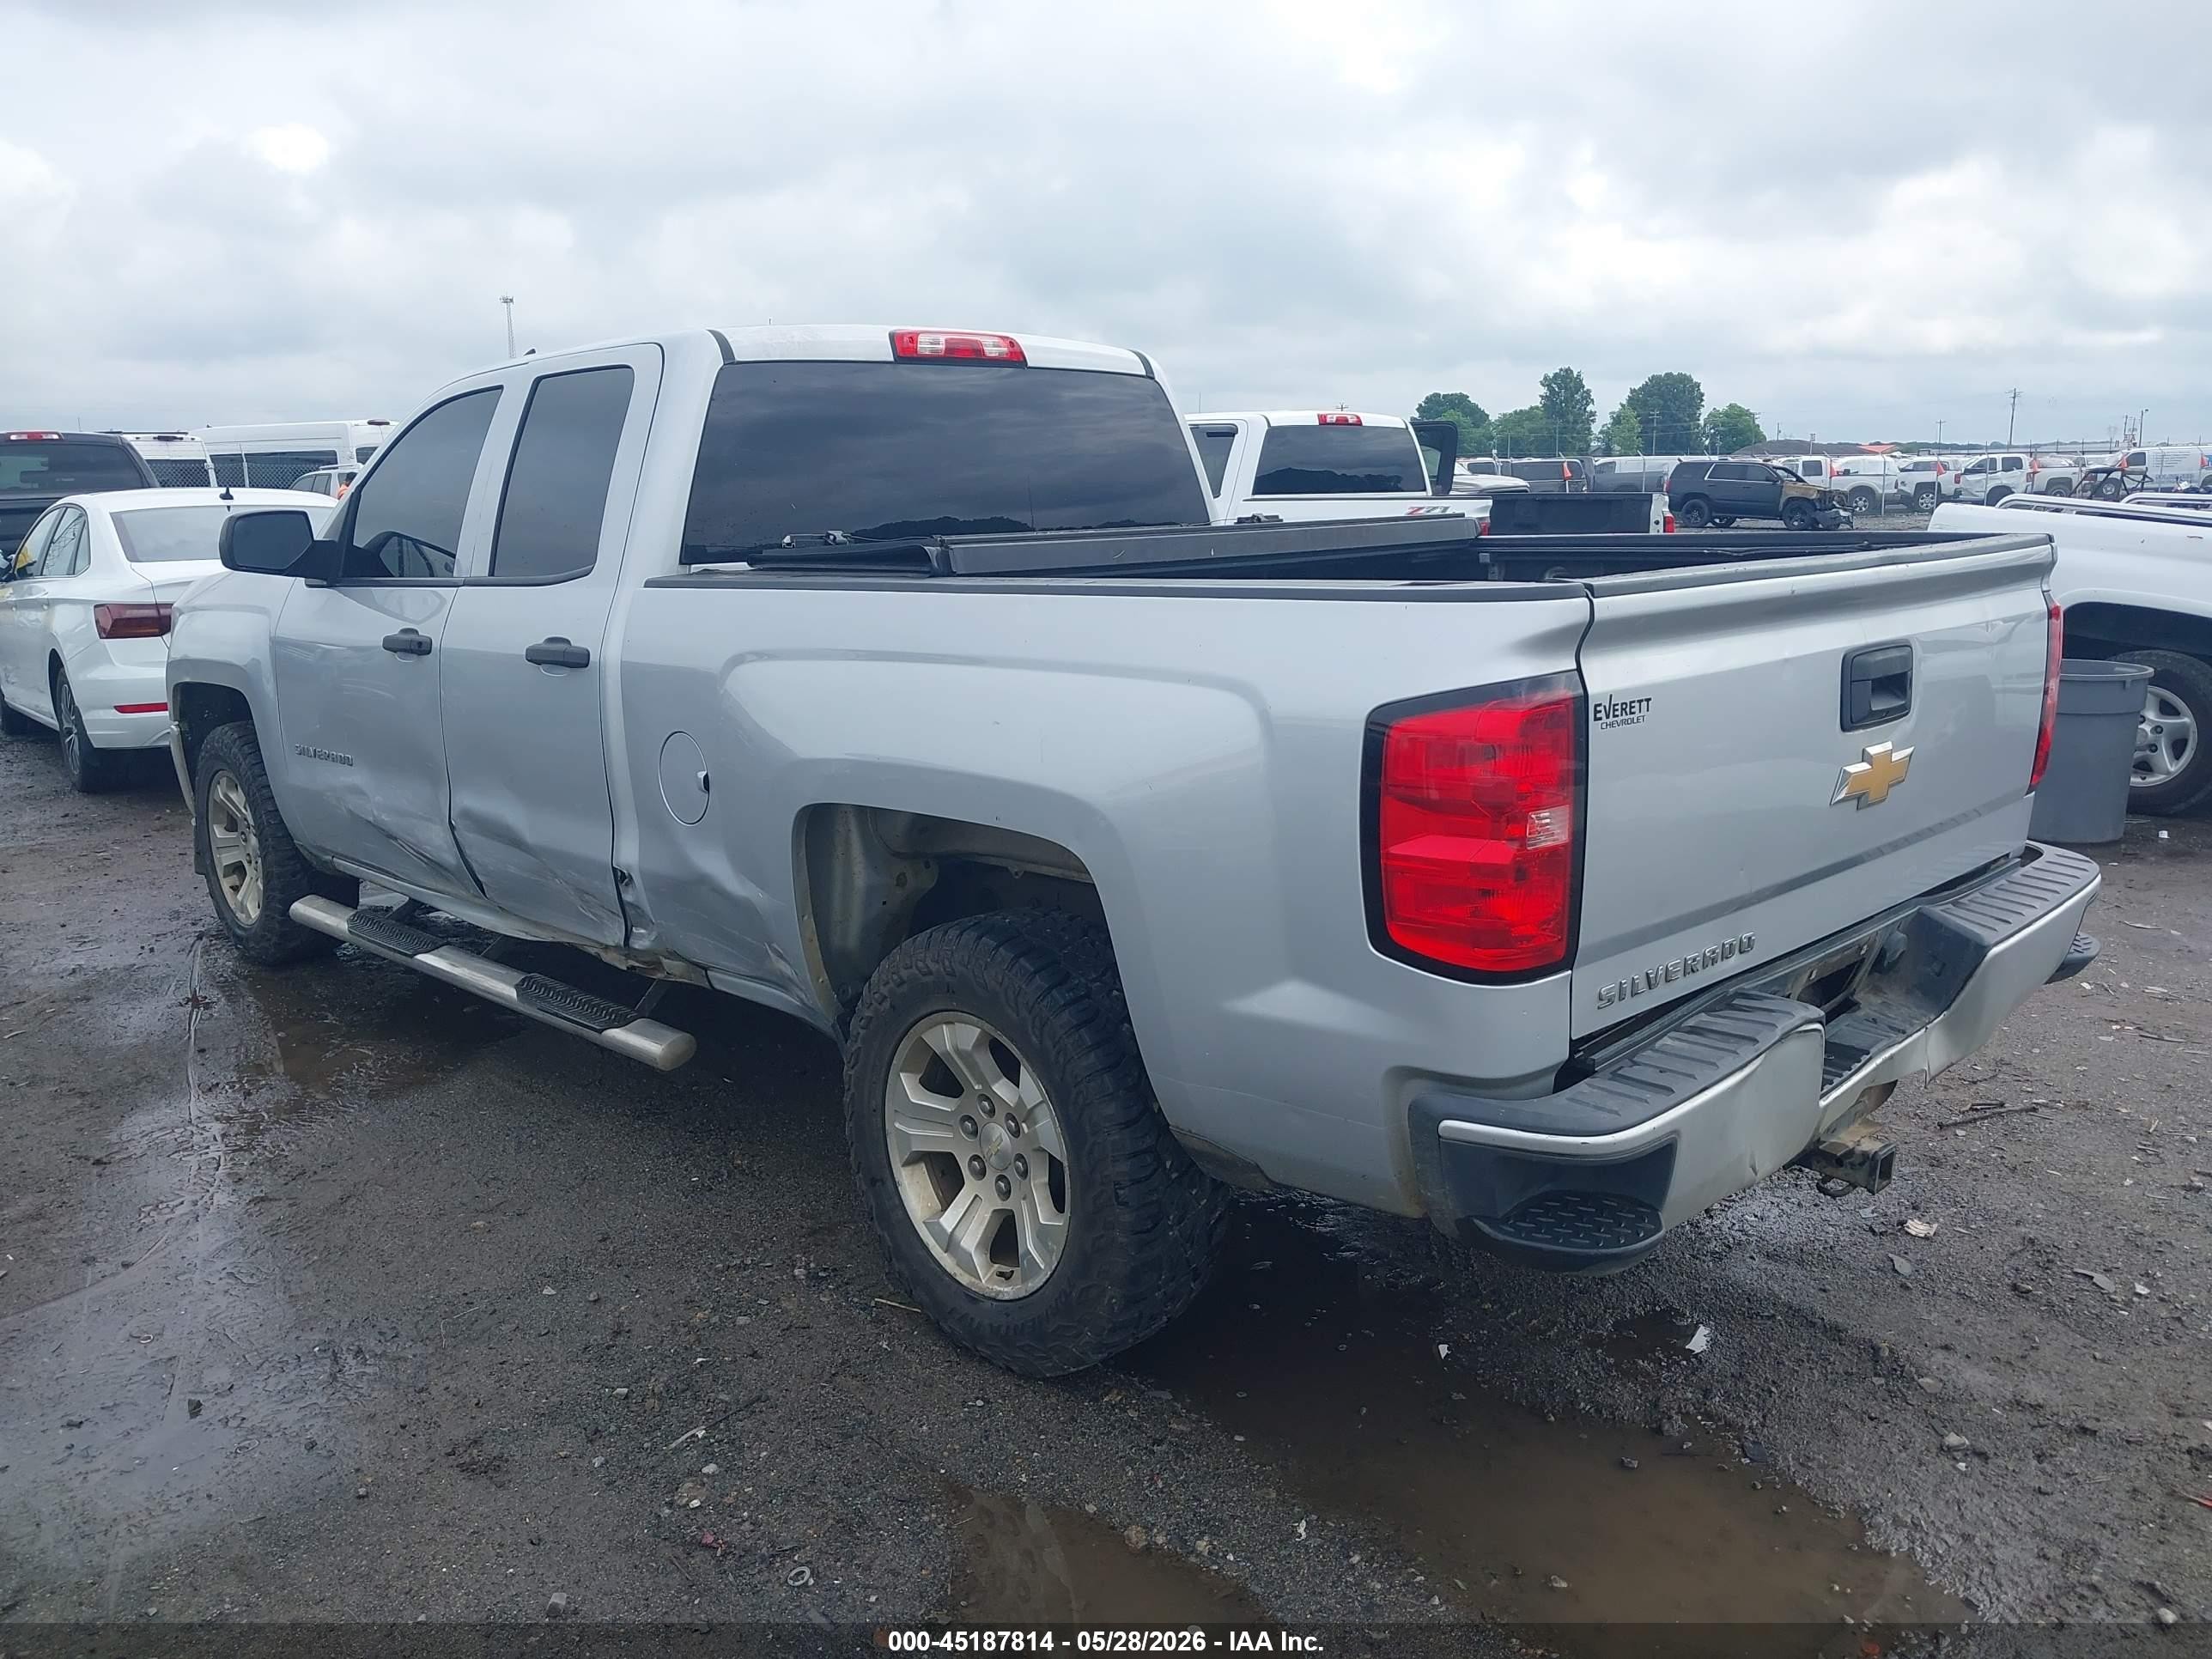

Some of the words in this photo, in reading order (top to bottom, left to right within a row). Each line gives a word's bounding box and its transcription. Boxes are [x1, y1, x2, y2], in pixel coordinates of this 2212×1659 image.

[1407, 506, 1450, 516] Z71
[1593, 693, 1652, 722] EVERETT
[1600, 714, 1646, 730] CHEVROLET
[295, 744, 354, 767] SILVERADO
[1596, 931, 1756, 1010] SILVERADO
